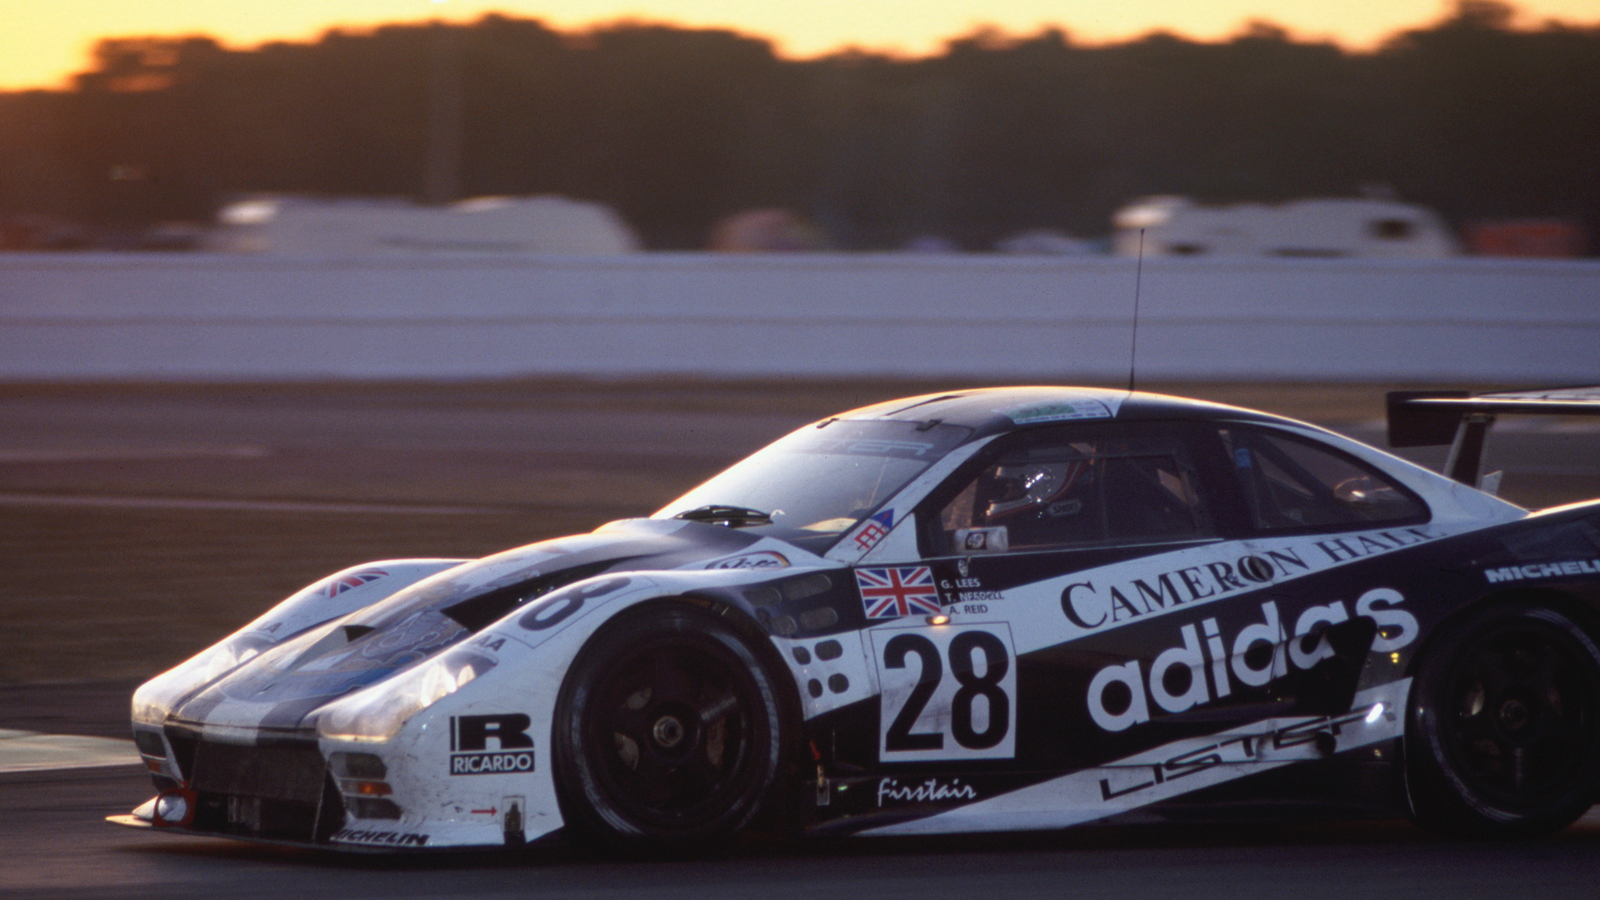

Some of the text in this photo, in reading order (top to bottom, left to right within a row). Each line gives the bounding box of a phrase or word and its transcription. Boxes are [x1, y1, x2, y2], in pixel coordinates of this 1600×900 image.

[1484, 559, 1600, 583] MICHELI
[955, 578, 981, 588] LEES
[964, 604, 989, 614] REID
[1087, 588, 1419, 732] adidas
[883, 630, 1009, 752] 28
[453, 753, 532, 773] RICARDO
